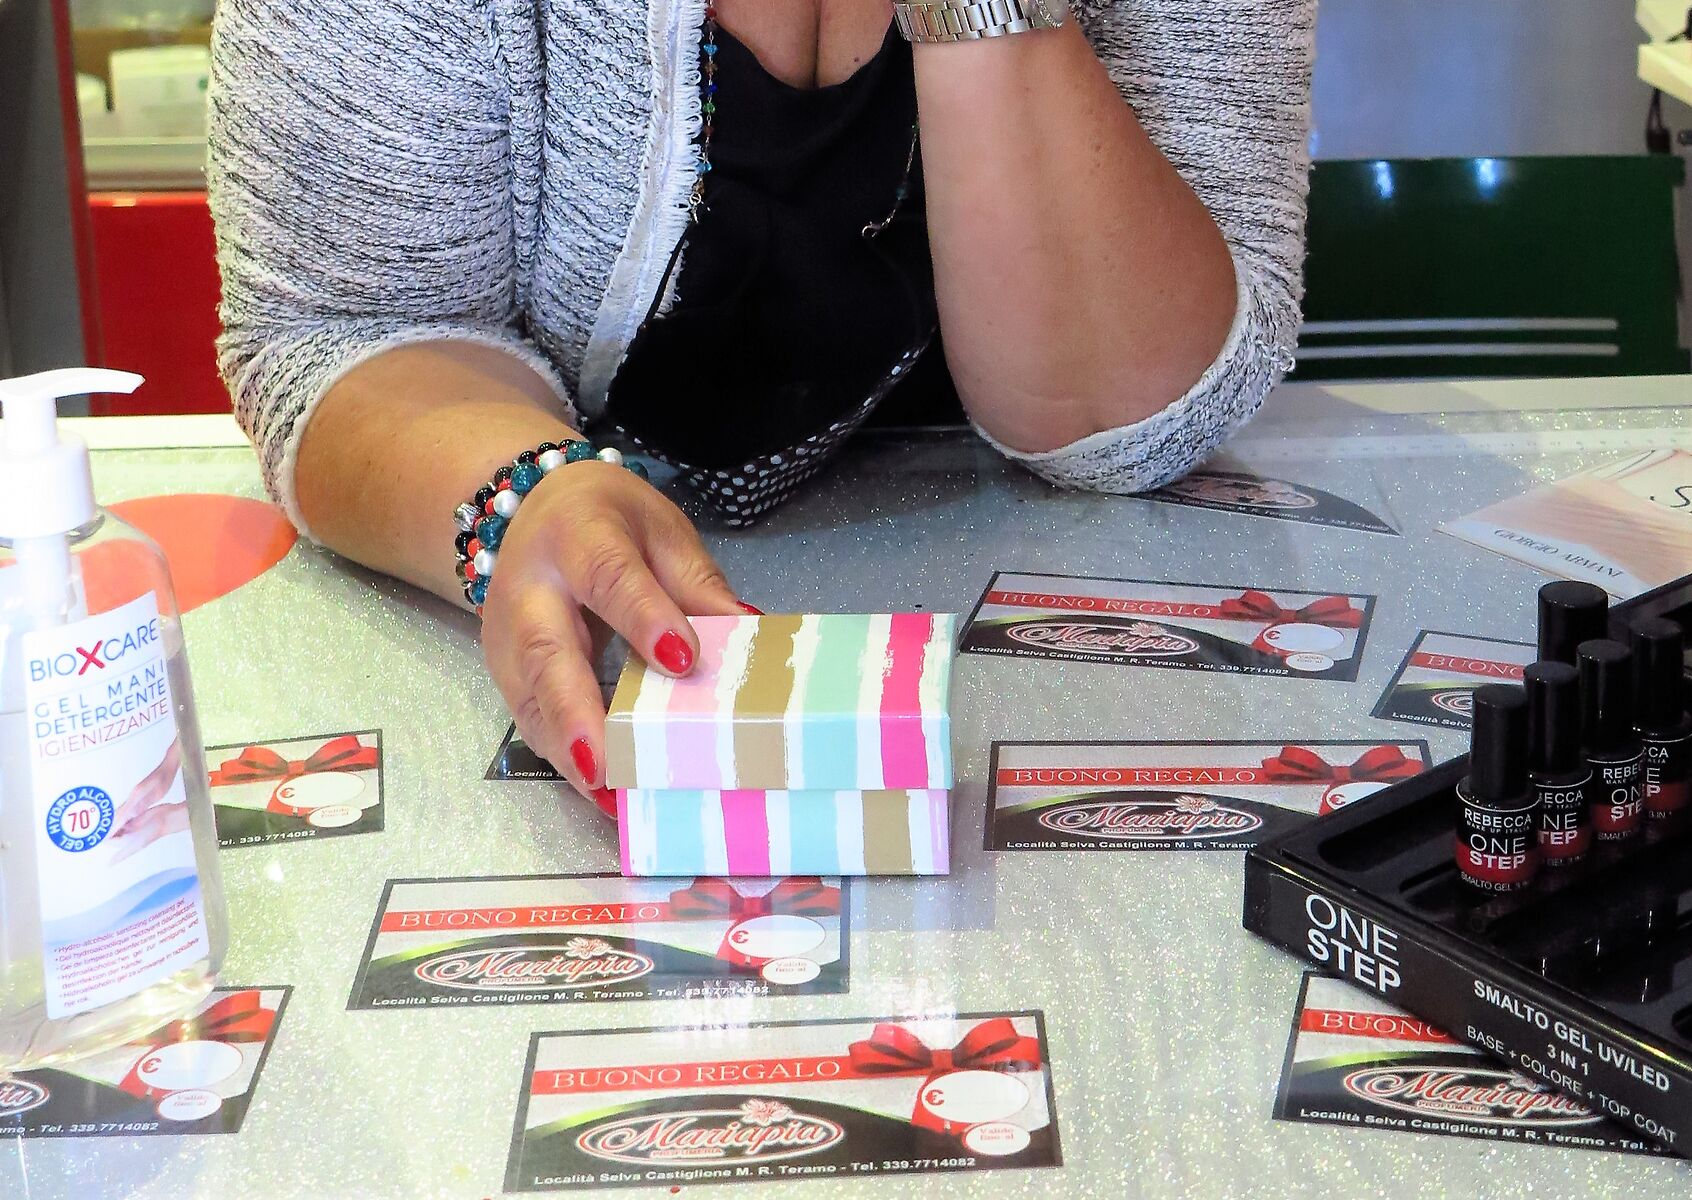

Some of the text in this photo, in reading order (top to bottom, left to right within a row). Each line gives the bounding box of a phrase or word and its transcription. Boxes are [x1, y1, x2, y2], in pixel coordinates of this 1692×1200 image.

[1494, 528, 1625, 578] GIORGIO ARMANI
[1001, 593, 1212, 617] BUONO REGALO
[970, 646, 1013, 654] Località
[1016, 649, 1046, 657] Selva
[1049, 652, 1111, 662] Castiglione
[1145, 658, 1187, 668] Teramo
[1197, 663, 1217, 671] Tel.
[1220, 664, 1289, 675] 339.7714082
[34, 658, 165, 719] GEL MANI
[35, 677, 167, 739] DETERGENTE
[1392, 711, 1438, 724] Località
[38, 697, 169, 758] IGIENIZZANTE
[1015, 770, 1256, 783] BUONO REGALO
[1603, 763, 1641, 779] REBE
[1540, 790, 1584, 804] ECCA
[1611, 784, 1645, 805] ON
[48, 788, 113, 851] HYDRO ALCOHOLIC GEL
[1057, 806, 1249, 834] Mariapia
[1464, 808, 1532, 828] REBECCA
[1542, 812, 1578, 831] NE
[1610, 800, 1642, 820] STE
[239, 829, 317, 845] 339.7714082
[1466, 820, 1486, 832] MAKE
[1538, 830, 1578, 845] TEP
[1006, 841, 1057, 849] Località
[1060, 841, 1096, 849] Selva
[1099, 841, 1171, 851] Castiglione
[1174, 841, 1190, 849] M.
[1193, 841, 1207, 849] R.
[1470, 833, 1526, 855] ONE
[1469, 850, 1526, 870] STEP
[1460, 871, 1493, 890] SMALTO
[1494, 883, 1512, 892] GEL
[401, 905, 661, 928] BUONO REGALO
[1305, 893, 1400, 965] ONE
[432, 951, 640, 983] Mariapia
[1306, 928, 1401, 993] STEP
[372, 996, 427, 1006] Località
[431, 995, 468, 1004] Selva
[472, 994, 550, 1003] Castiglione
[554, 992, 570, 1000] M.
[574, 991, 588, 999] R.
[592, 990, 644, 999] Teramo
[656, 988, 680, 998] Tel.
[1474, 979, 1670, 1092] SMALTO GEL UV/LED
[1546, 1044, 1590, 1076] 3 IN 1
[553, 1060, 841, 1089] BUONO REGALO
[1466, 1024, 1505, 1055] BASE
[1520, 1054, 1583, 1094] COLORE
[1599, 1092, 1631, 1117] TOP
[1633, 1113, 1677, 1143] COAT
[41, 1124, 64, 1133] Tel.
[69, 1122, 160, 1134] 339.7714082
[598, 1115, 826, 1156] Mariapia
[1300, 1108, 1361, 1123] Località
[1364, 1115, 1407, 1127] Selva
[1411, 1119, 1498, 1137] Castiglione
[1502, 1127, 1521, 1138] M.
[1525, 1130, 1541, 1141] R.
[1545, 1132, 1606, 1147] Teramo
[1619, 1139, 1649, 1150] Tel.
[534, 1174, 595, 1186] Località
[599, 1171, 642, 1183] Selva
[648, 1168, 732, 1183] Castiglione
[735, 1167, 755, 1177] M.
[758, 1165, 775, 1176] R.
[778, 1164, 837, 1175] Teramo
[850, 1161, 879, 1172] Tel.
[882, 1157, 976, 1170] 339.7714082
